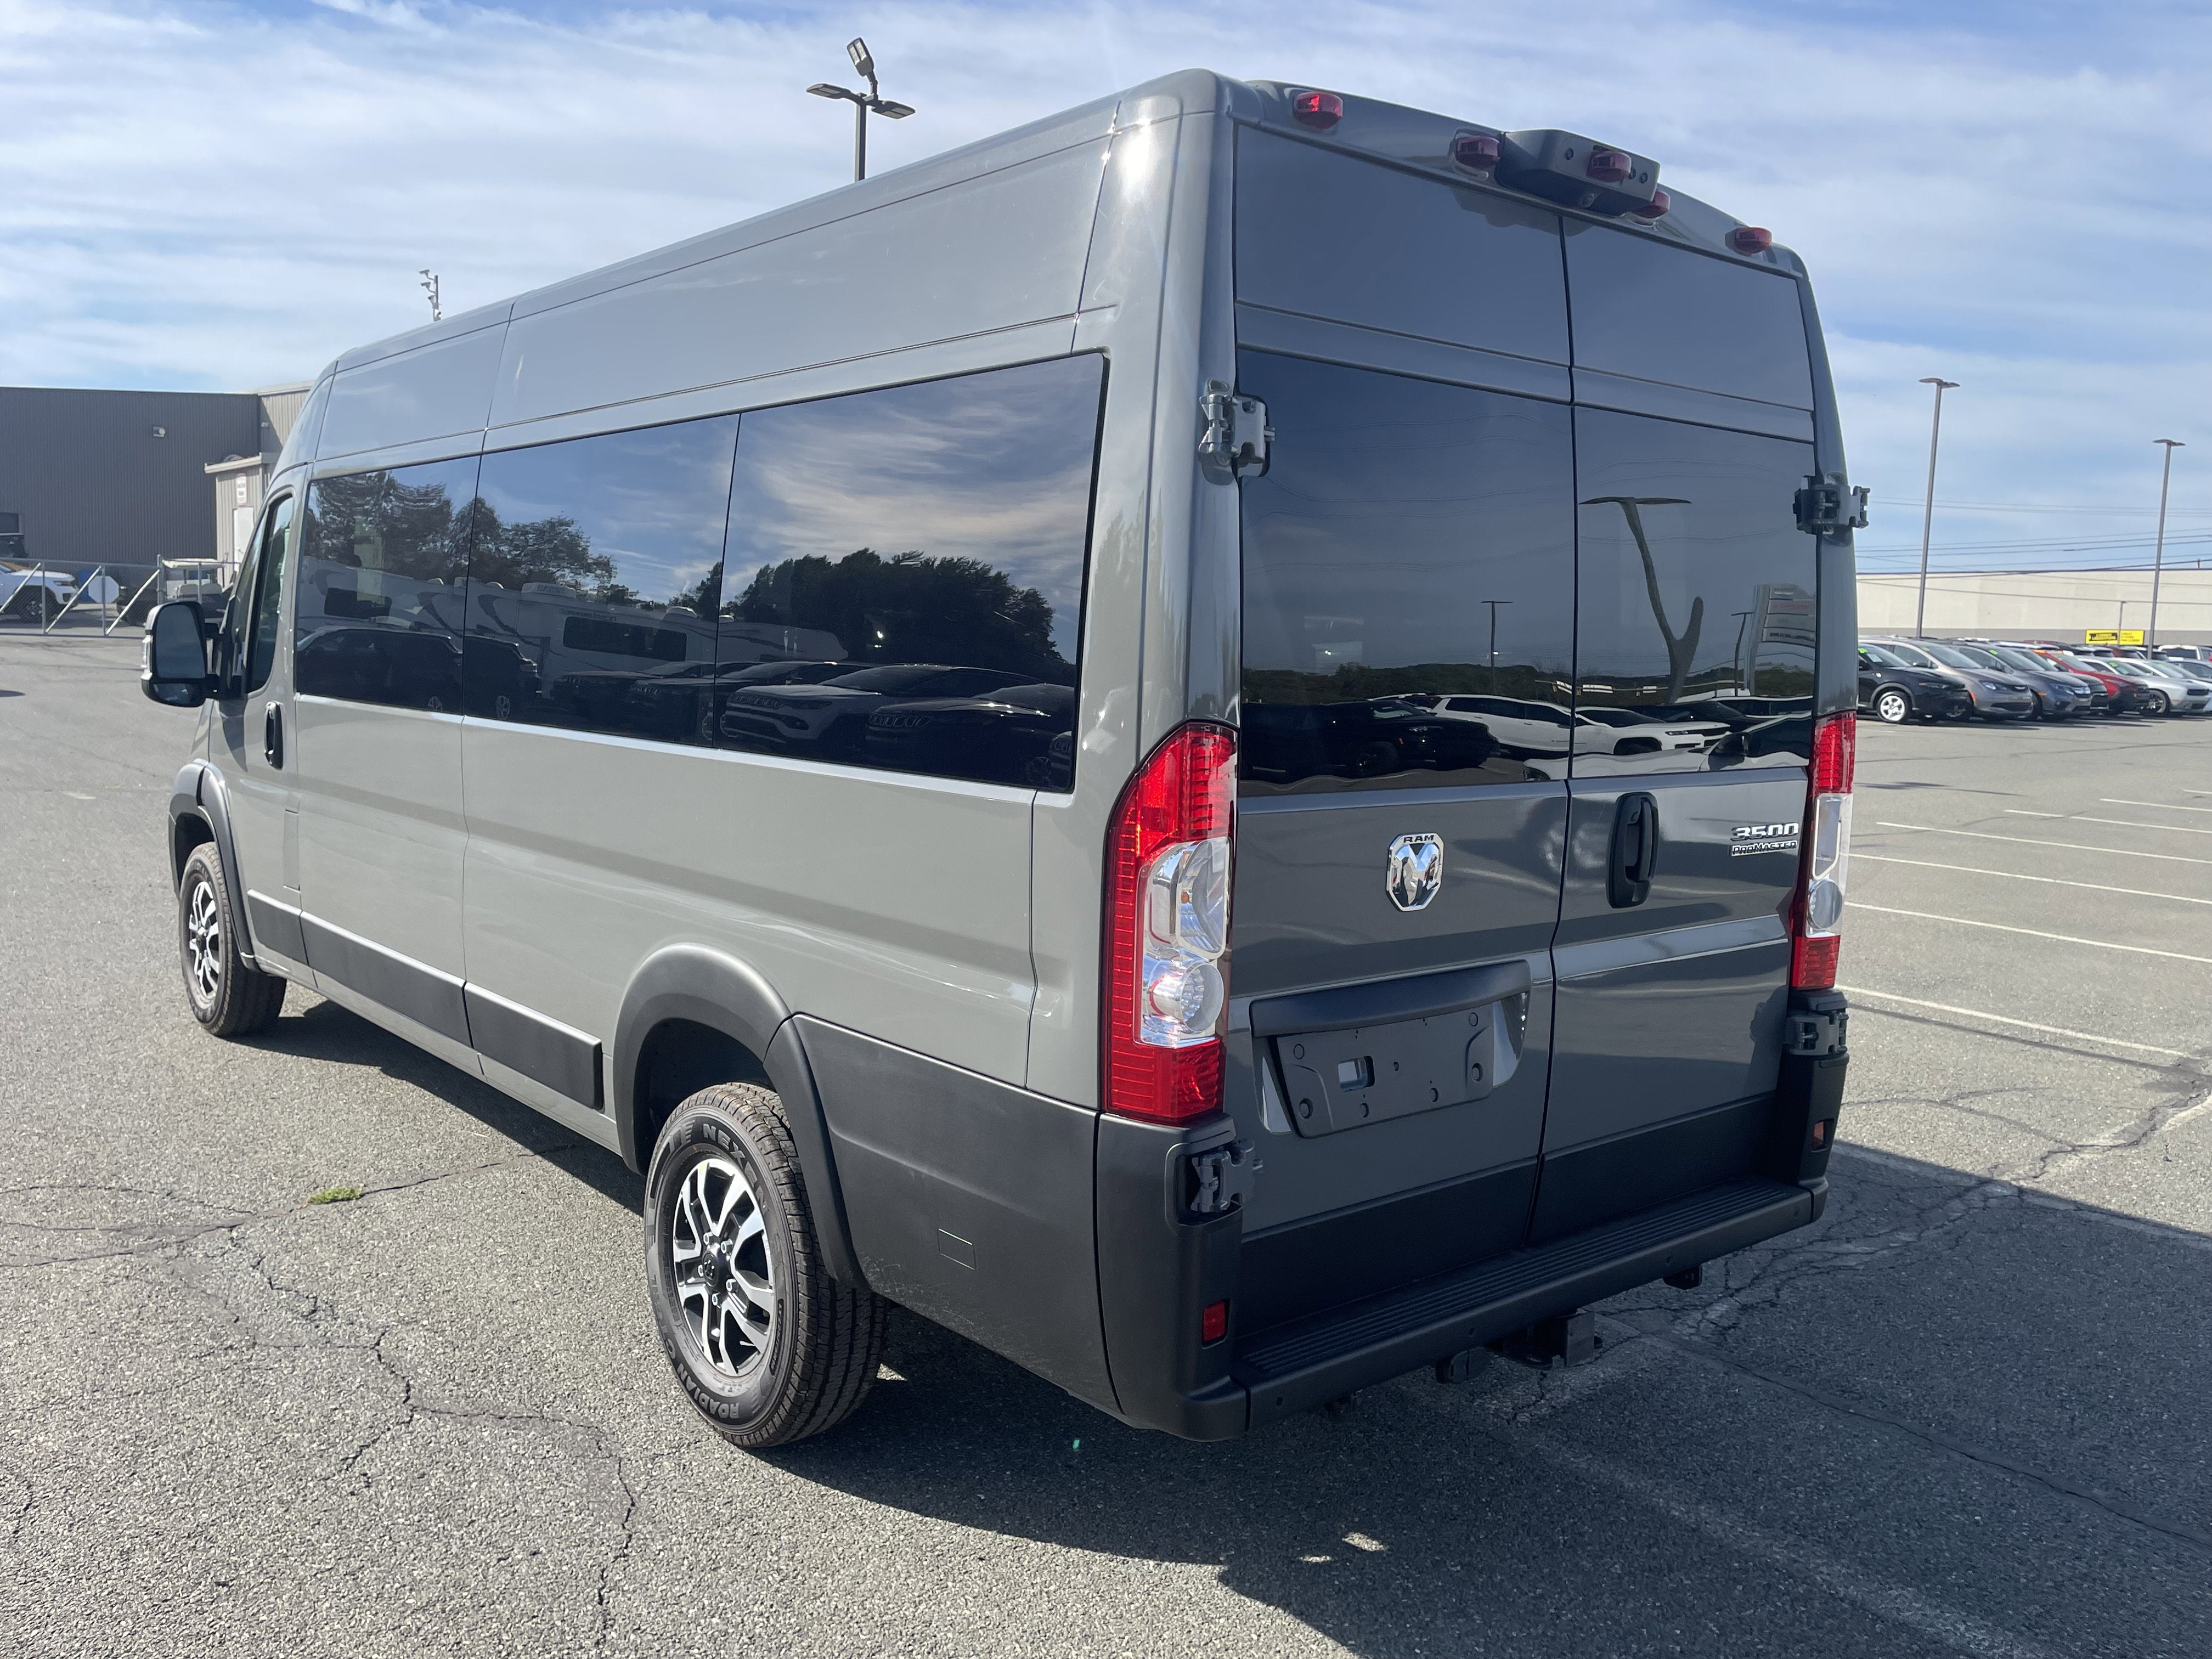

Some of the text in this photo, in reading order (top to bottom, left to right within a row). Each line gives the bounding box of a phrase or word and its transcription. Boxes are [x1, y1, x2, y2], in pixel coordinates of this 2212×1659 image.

[1403, 835, 1435, 843] RAM
[1731, 822, 1799, 841] 3500
[703, 1122, 769, 1216] NEXEN
[676, 1363, 740, 1419] ROADIAN
